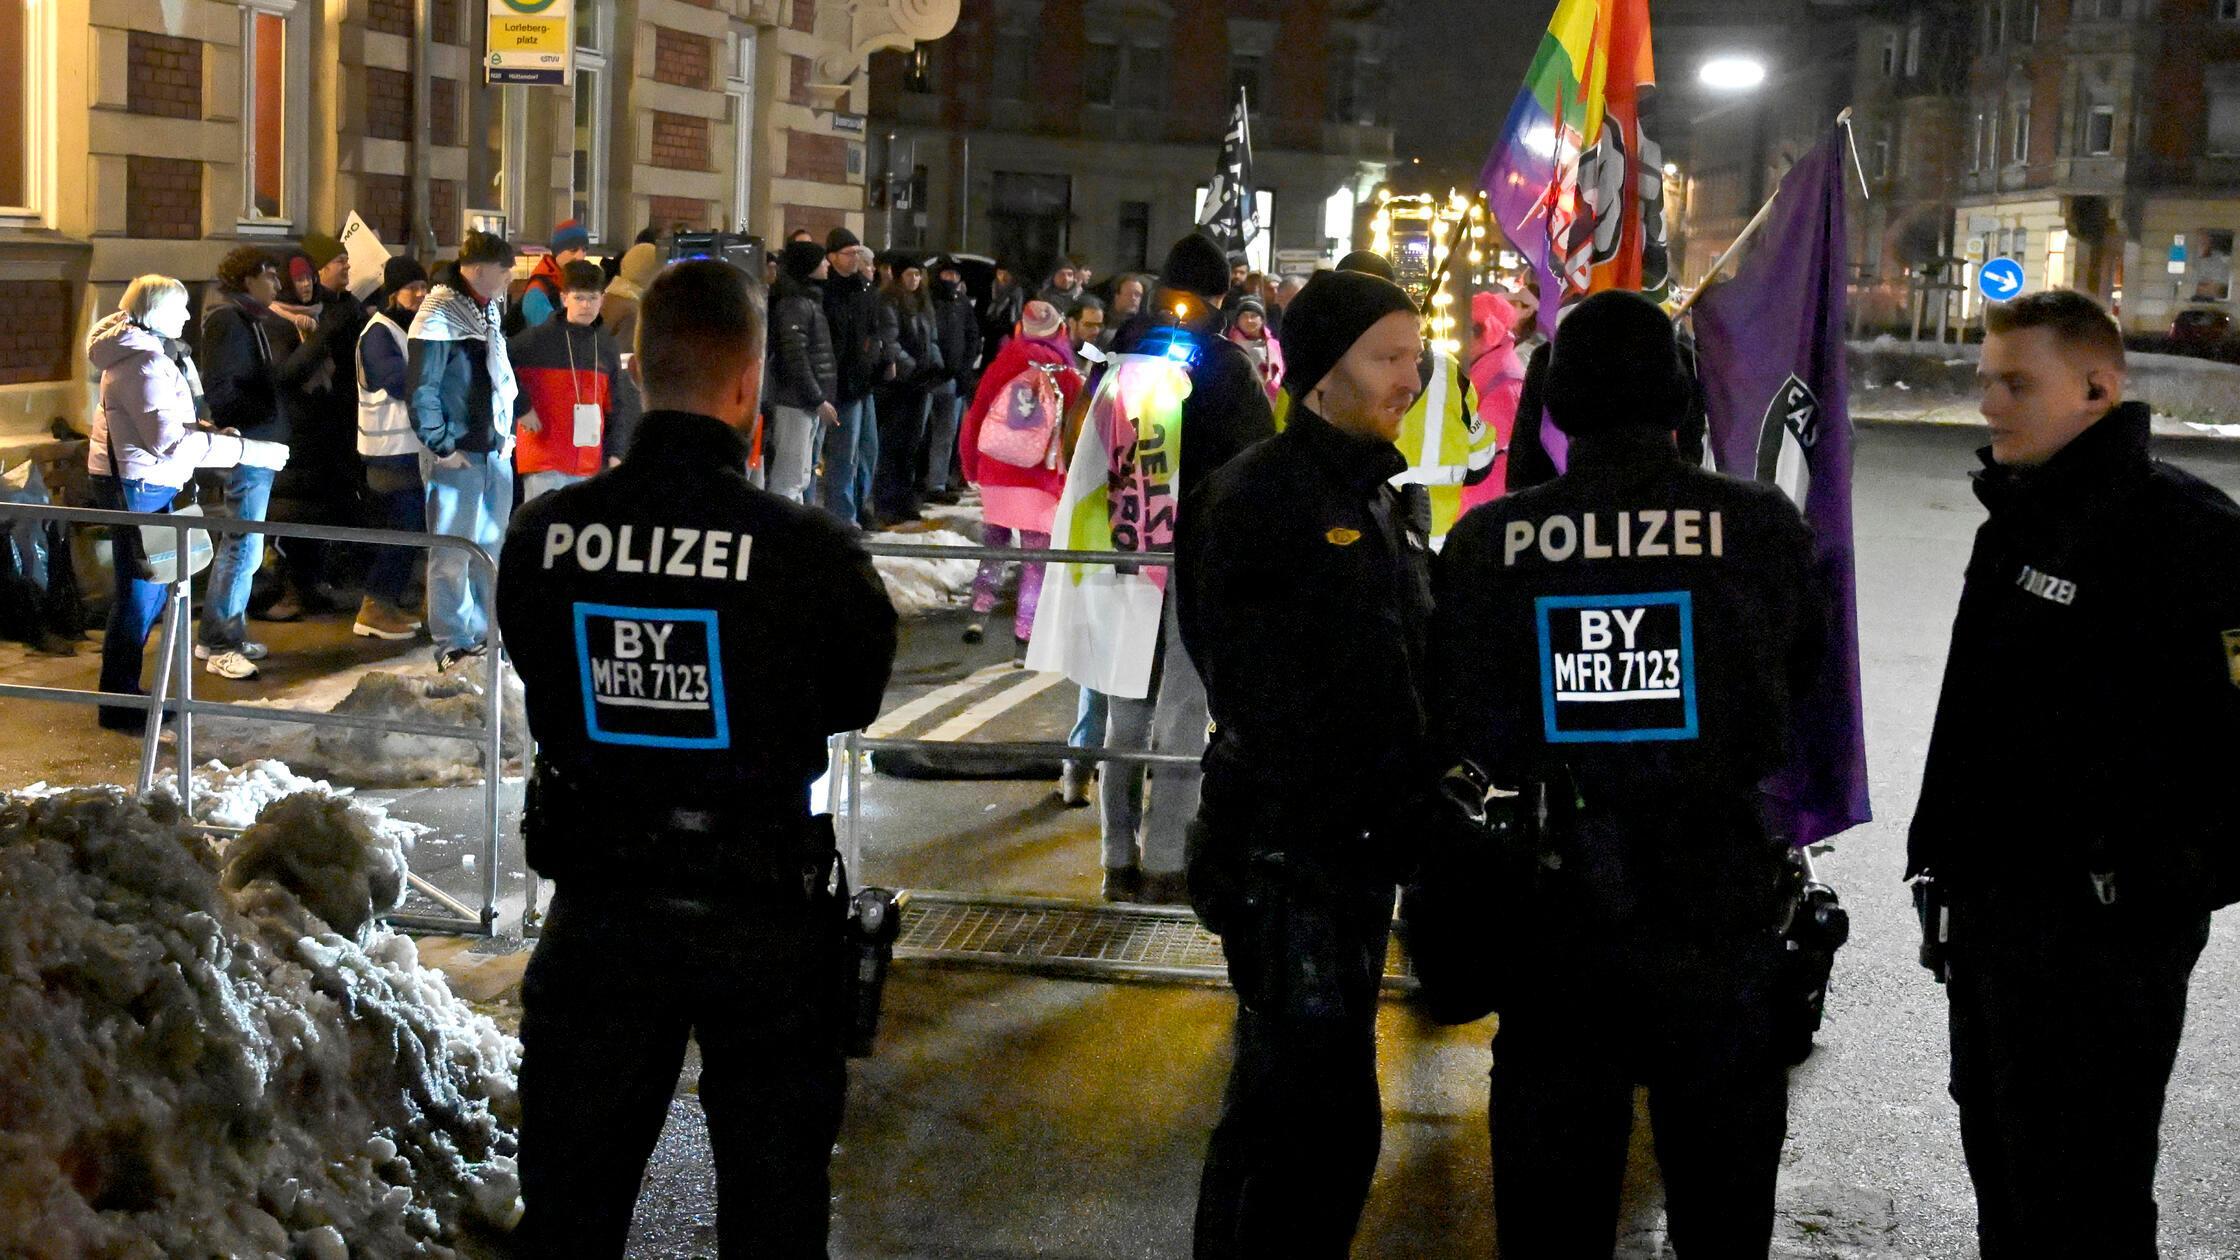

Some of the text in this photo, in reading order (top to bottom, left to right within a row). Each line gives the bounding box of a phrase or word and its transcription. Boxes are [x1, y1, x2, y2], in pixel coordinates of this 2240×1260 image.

[505, 23, 551, 34] Lorleberg-
[516, 36, 538, 45] platz
[543, 523, 753, 581] POLIZEI
[1504, 510, 1723, 566] POLIZEI
[614, 620, 673, 660] BY
[1580, 608, 1646, 651] BY
[592, 657, 709, 700] MFR 7123
[1555, 649, 1680, 691] MFR 7123
